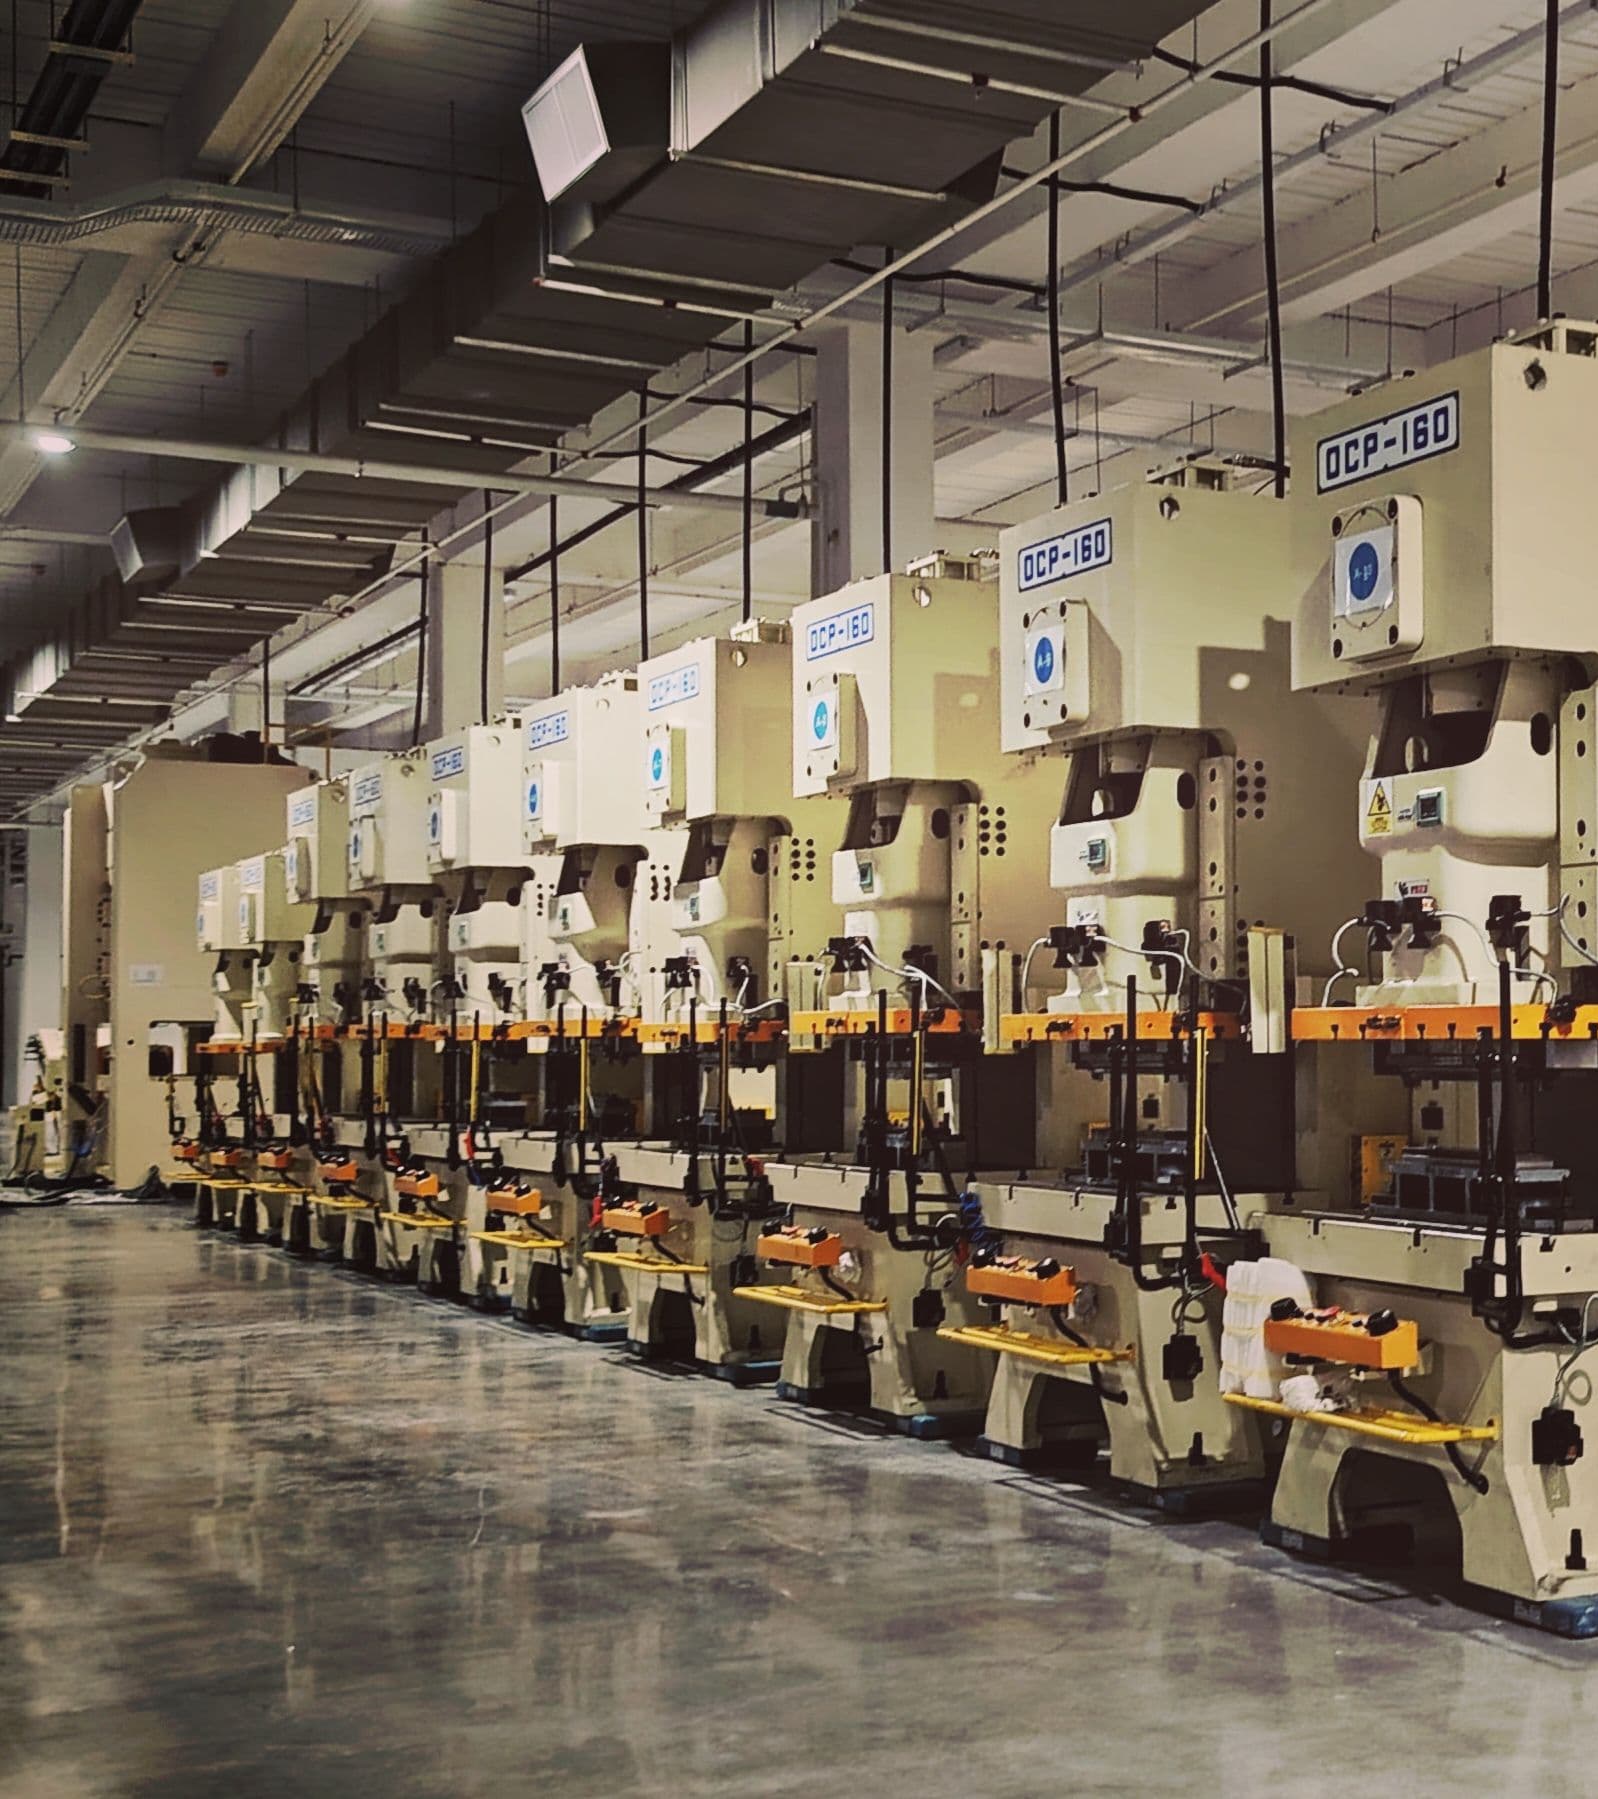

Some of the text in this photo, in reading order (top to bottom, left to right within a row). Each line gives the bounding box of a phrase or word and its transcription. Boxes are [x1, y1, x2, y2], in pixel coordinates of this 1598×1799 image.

[1326, 405, 1449, 481] OCP-160
[1024, 528, 1105, 582] OCP-160
[811, 611, 869, 652] OCP-160
